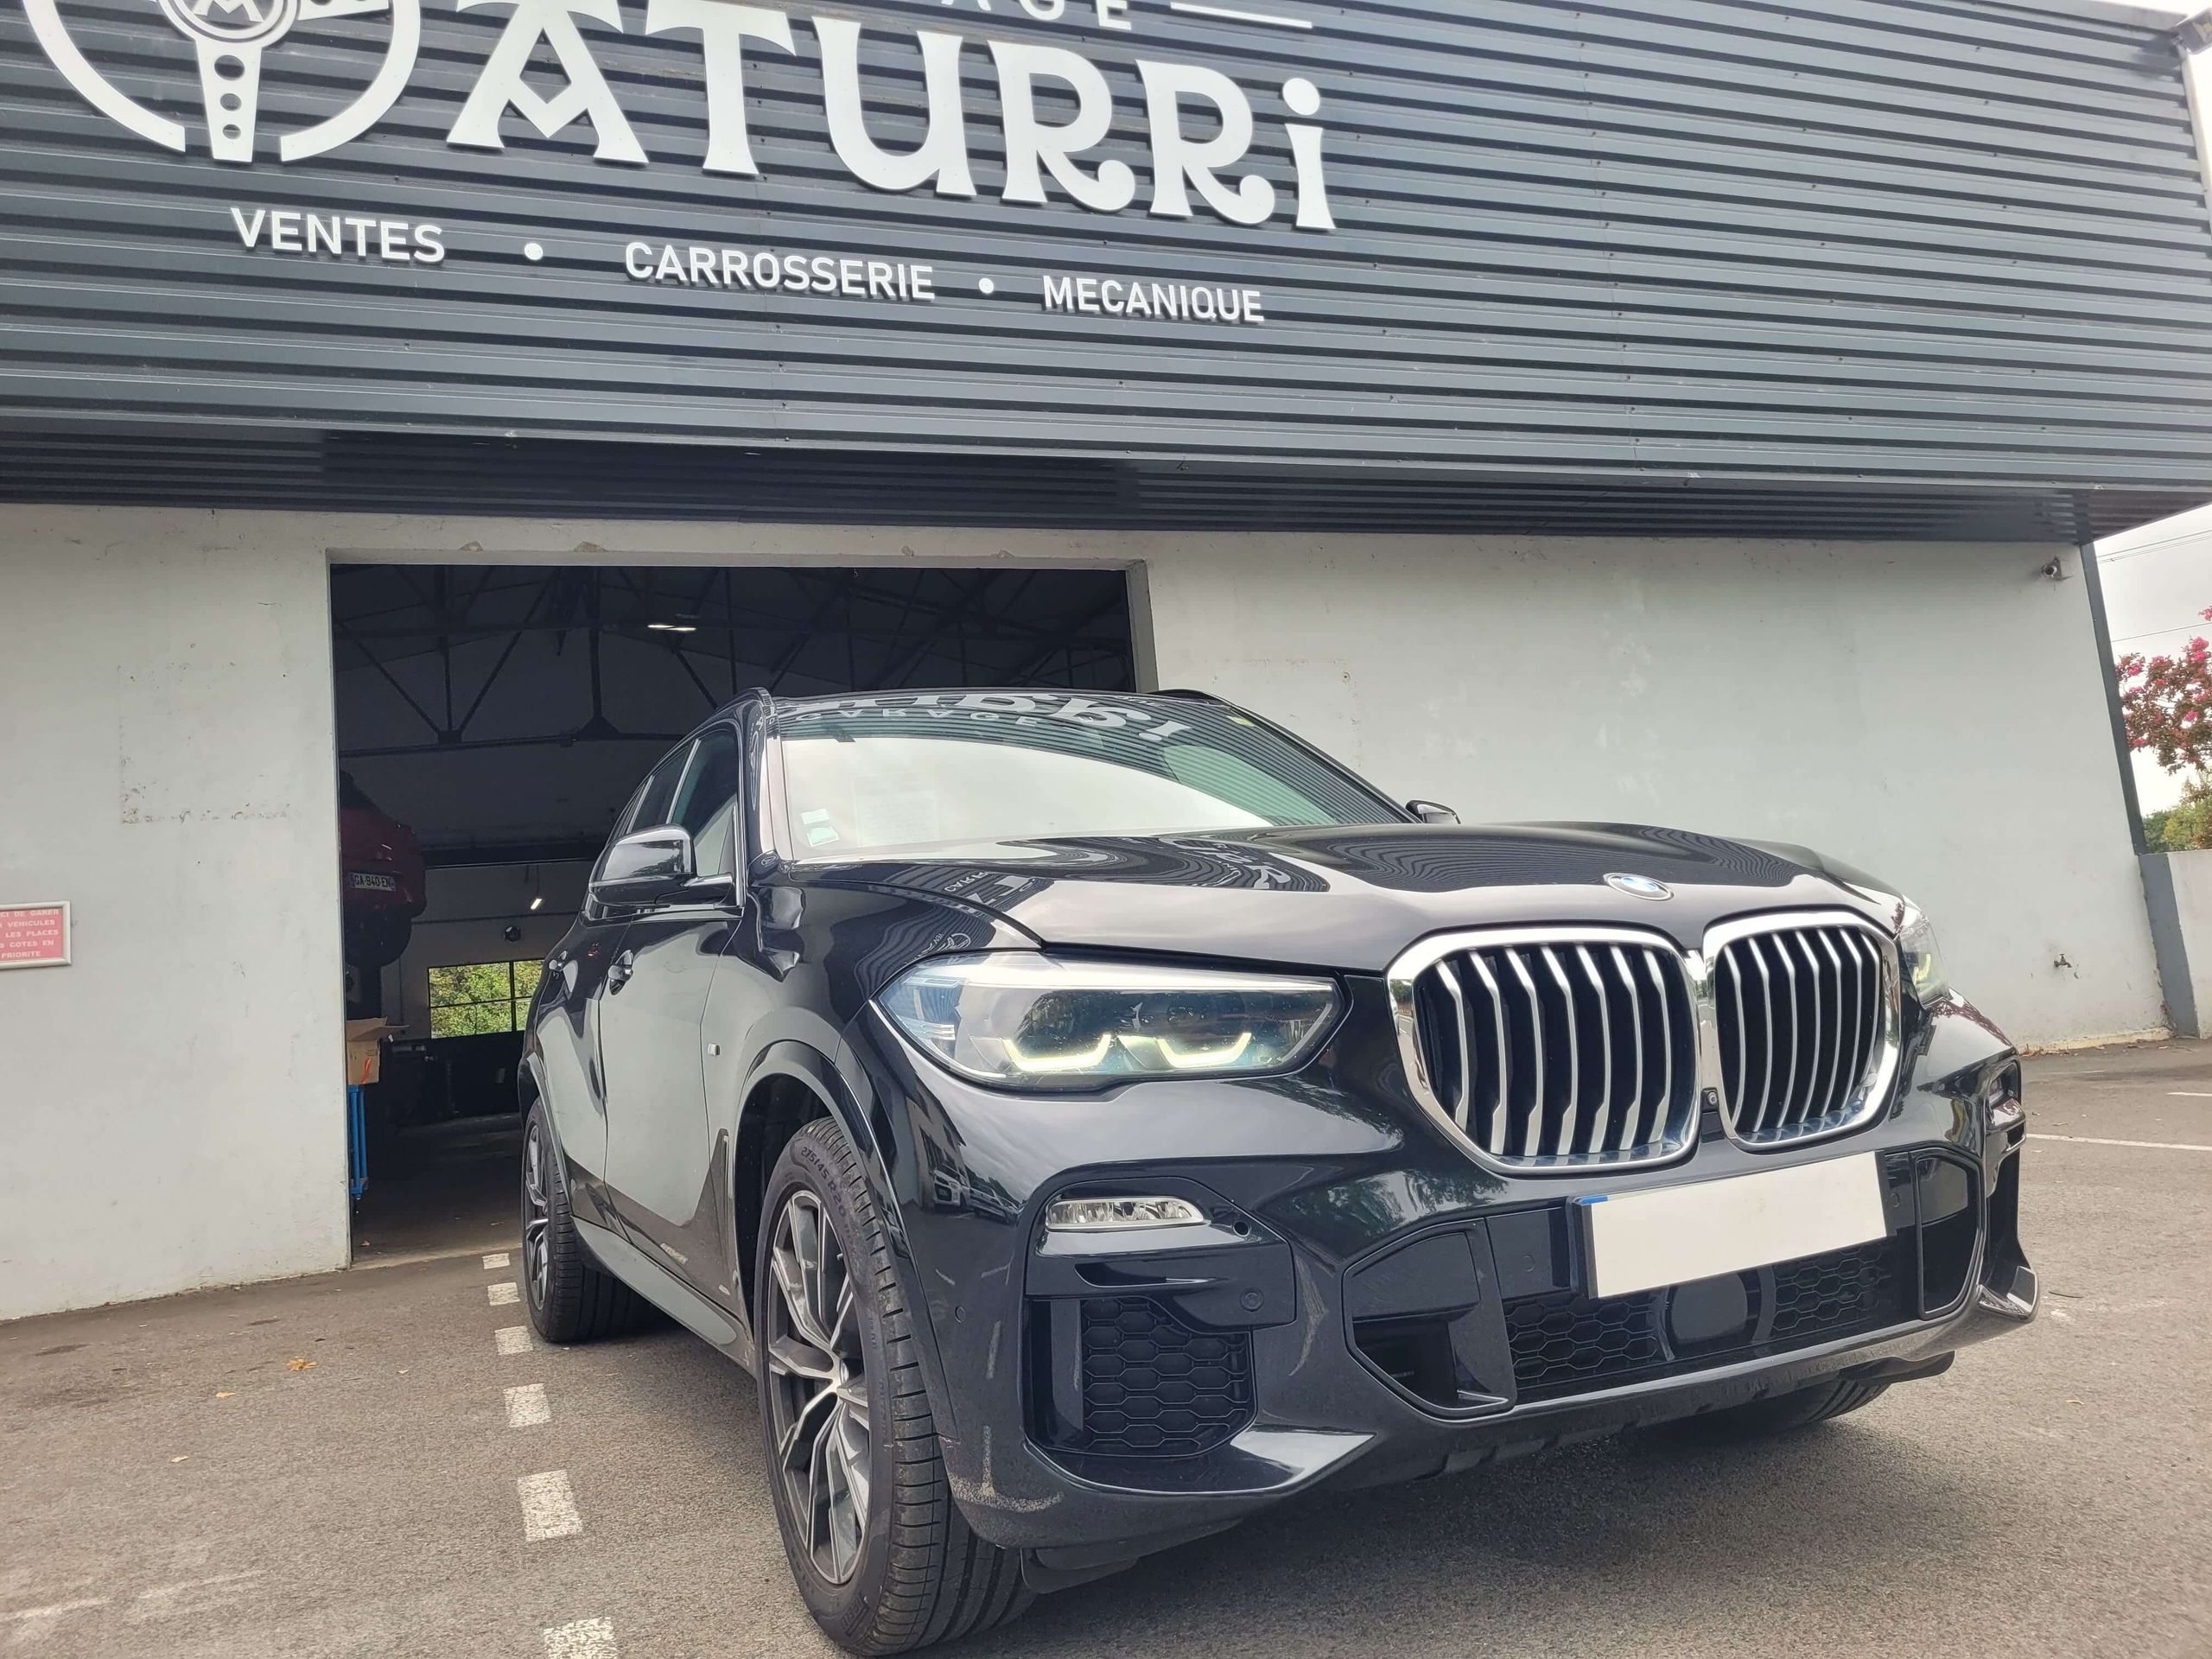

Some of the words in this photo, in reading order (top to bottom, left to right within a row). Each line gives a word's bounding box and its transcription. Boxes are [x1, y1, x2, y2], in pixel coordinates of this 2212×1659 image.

[230, 207, 446, 265] VENTES
[624, 240, 937, 301] CARROSSERIE
[1042, 274, 1266, 324] MECANIQUE
